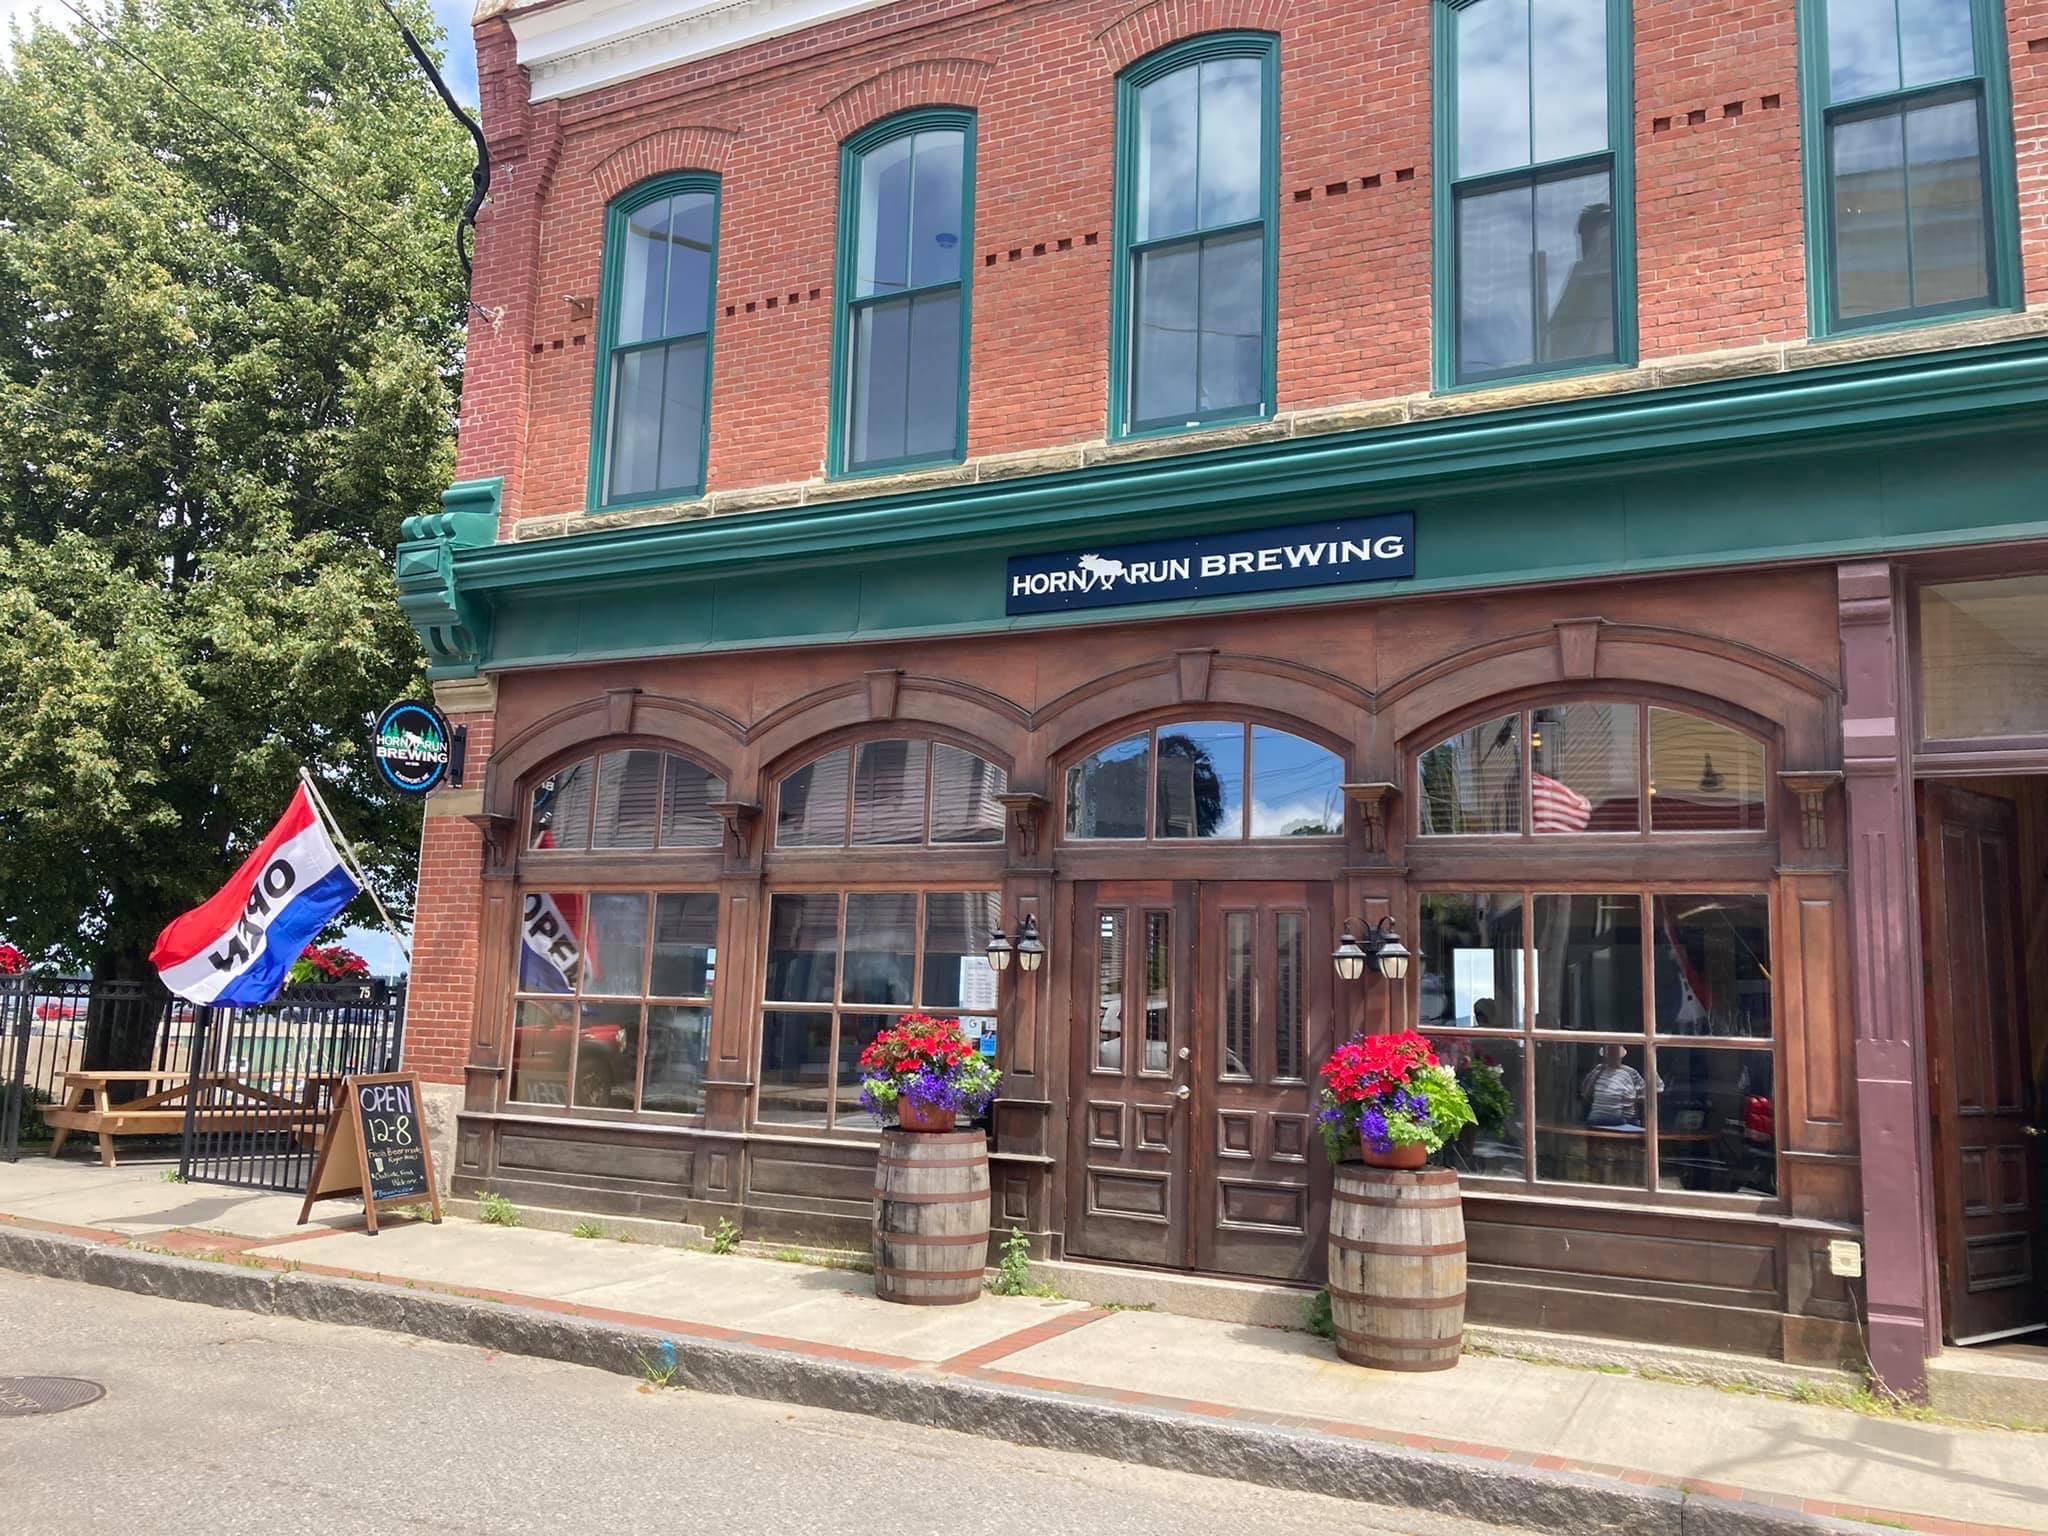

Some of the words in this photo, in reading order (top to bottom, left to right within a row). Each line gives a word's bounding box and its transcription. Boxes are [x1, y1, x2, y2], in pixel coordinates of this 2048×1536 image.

[1012, 567, 1088, 596] HORN
[1127, 557, 1190, 585] RUN
[1200, 535, 1405, 578] BREWING
[376, 734, 408, 747] HORN
[424, 740, 448, 752] RUN
[376, 746, 448, 763] BREWING
[359, 986, 371, 999] 75
[360, 1085, 412, 1113] OPEN
[367, 1115, 412, 1146] 12-8
